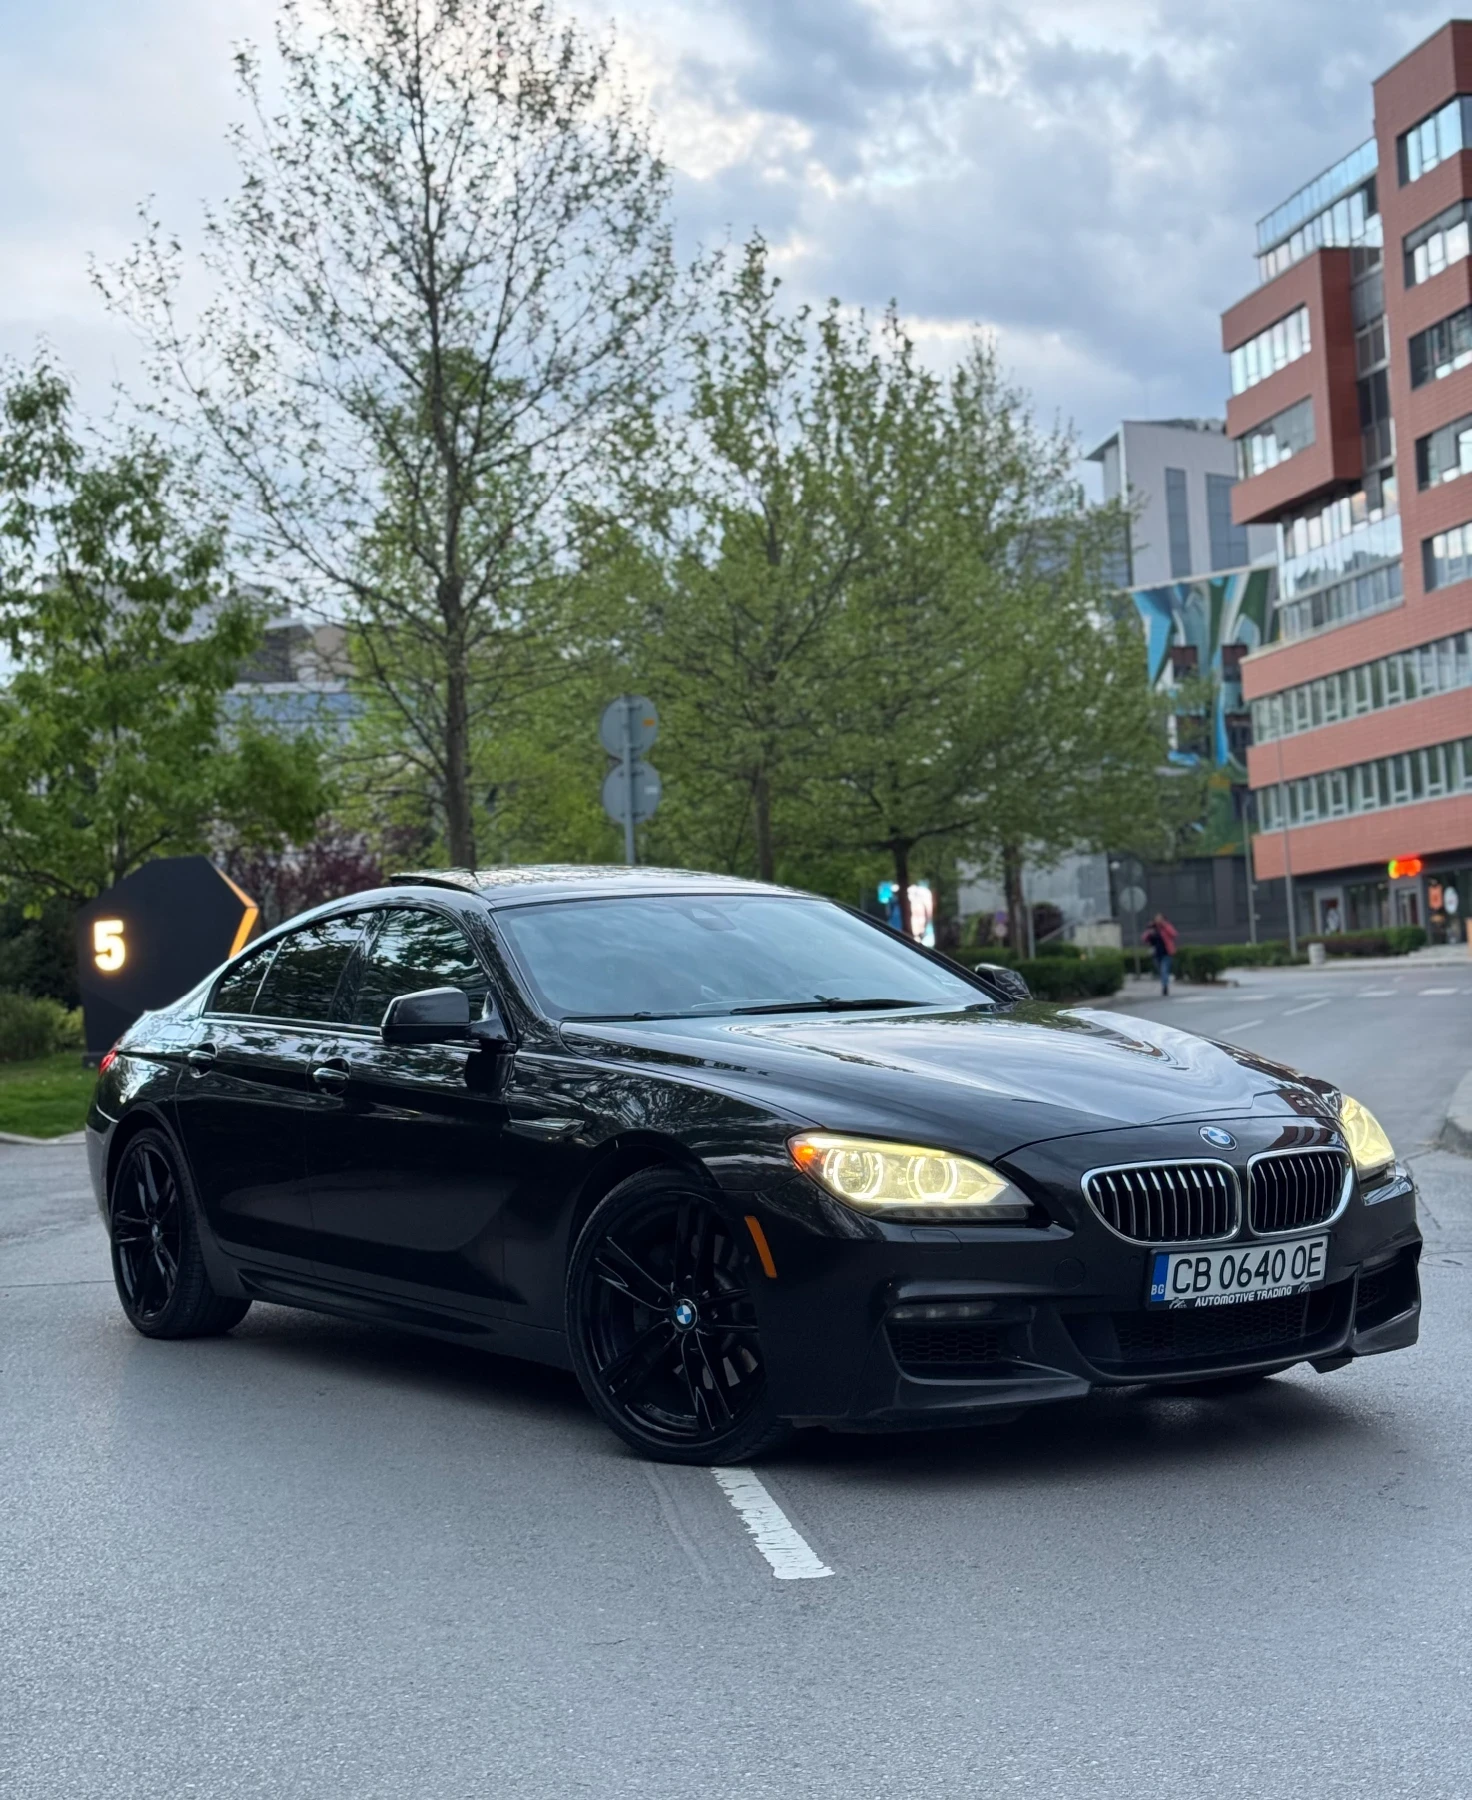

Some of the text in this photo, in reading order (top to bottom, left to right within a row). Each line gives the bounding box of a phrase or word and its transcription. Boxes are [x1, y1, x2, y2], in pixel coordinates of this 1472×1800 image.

[94, 919, 125, 971] 5
[1172, 1256, 1212, 1294] CB
[1219, 1248, 1286, 1290] 0640
[1151, 1284, 1165, 1296] BG
[1194, 1292, 1255, 1307] AUTOMOTIVE
